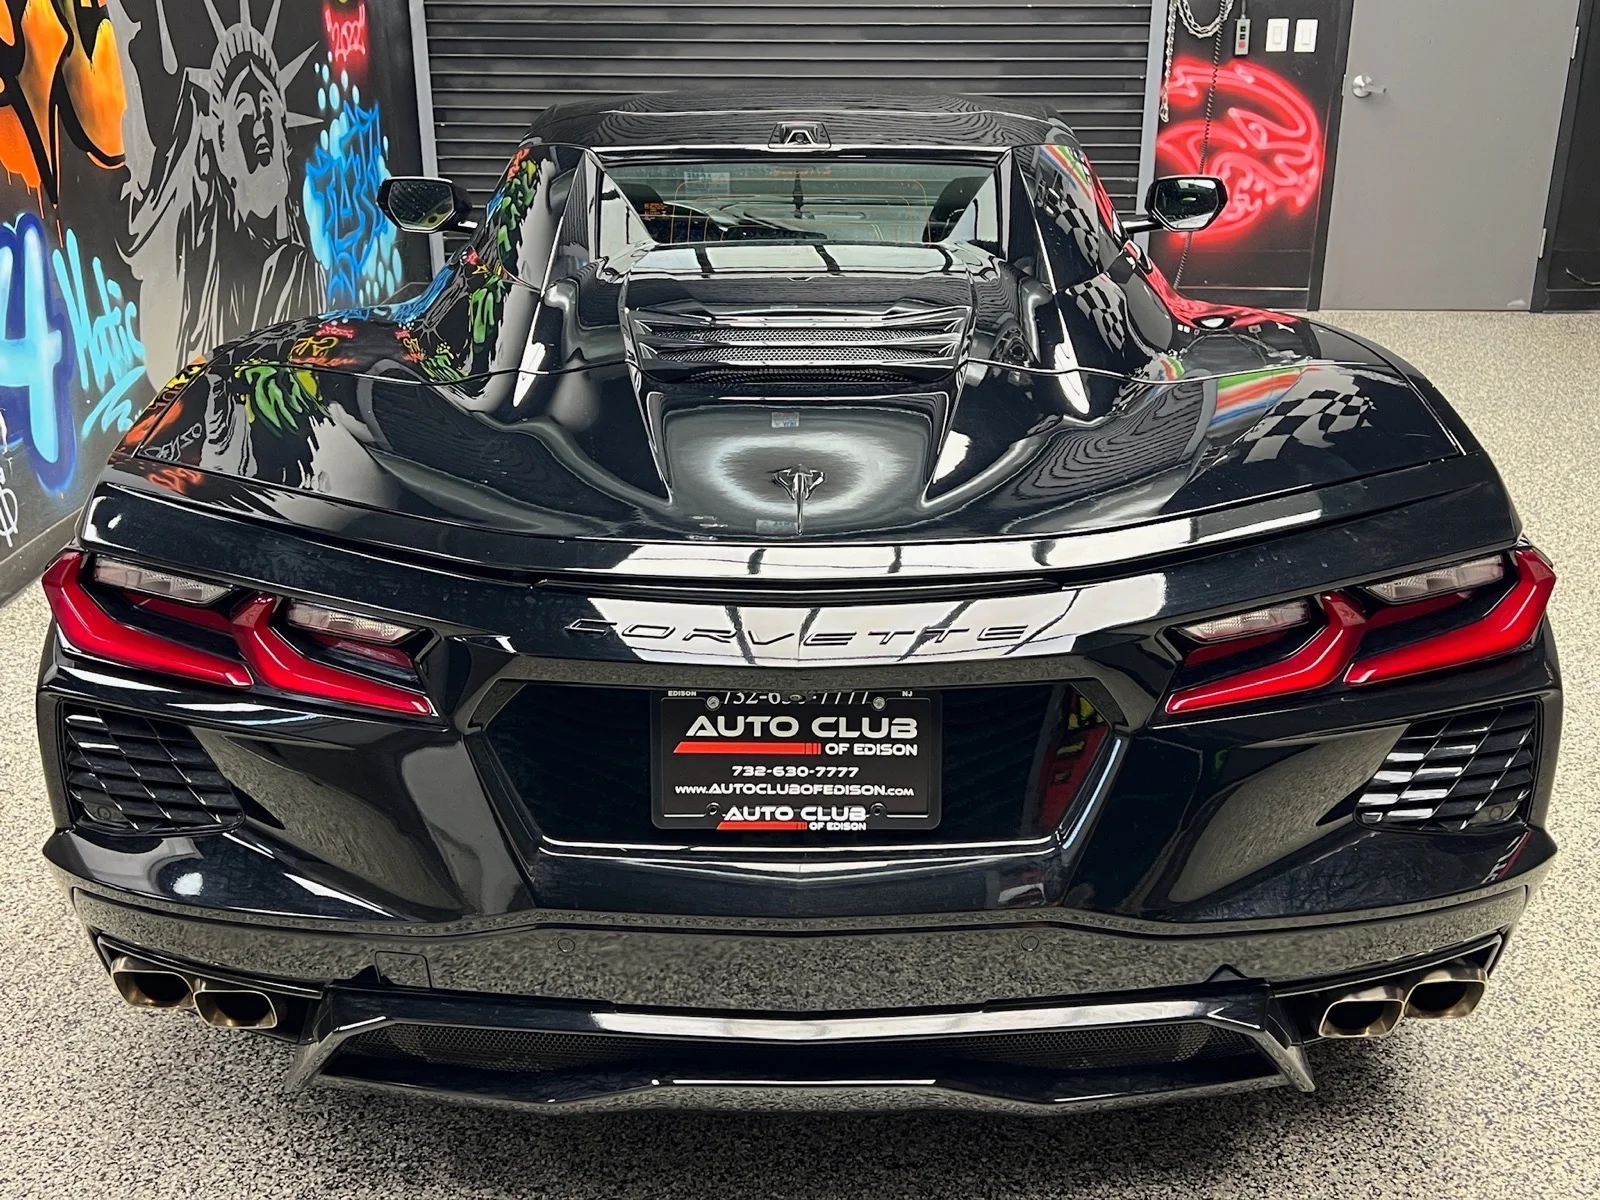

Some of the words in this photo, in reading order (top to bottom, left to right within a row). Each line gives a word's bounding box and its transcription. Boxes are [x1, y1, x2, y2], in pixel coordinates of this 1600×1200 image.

[565, 618, 1029, 646] CORVETTE
[685, 715, 800, 738] AUTO
[811, 716, 918, 739] CLUB
[824, 743, 850, 756] OF
[853, 743, 918, 757] EDISON
[731, 765, 860, 778] 732-630-7777
[723, 805, 794, 822] AUTO
[800, 805, 867, 822] CLUB
[808, 821, 825, 831] OF
[826, 821, 867, 832] EDISON
